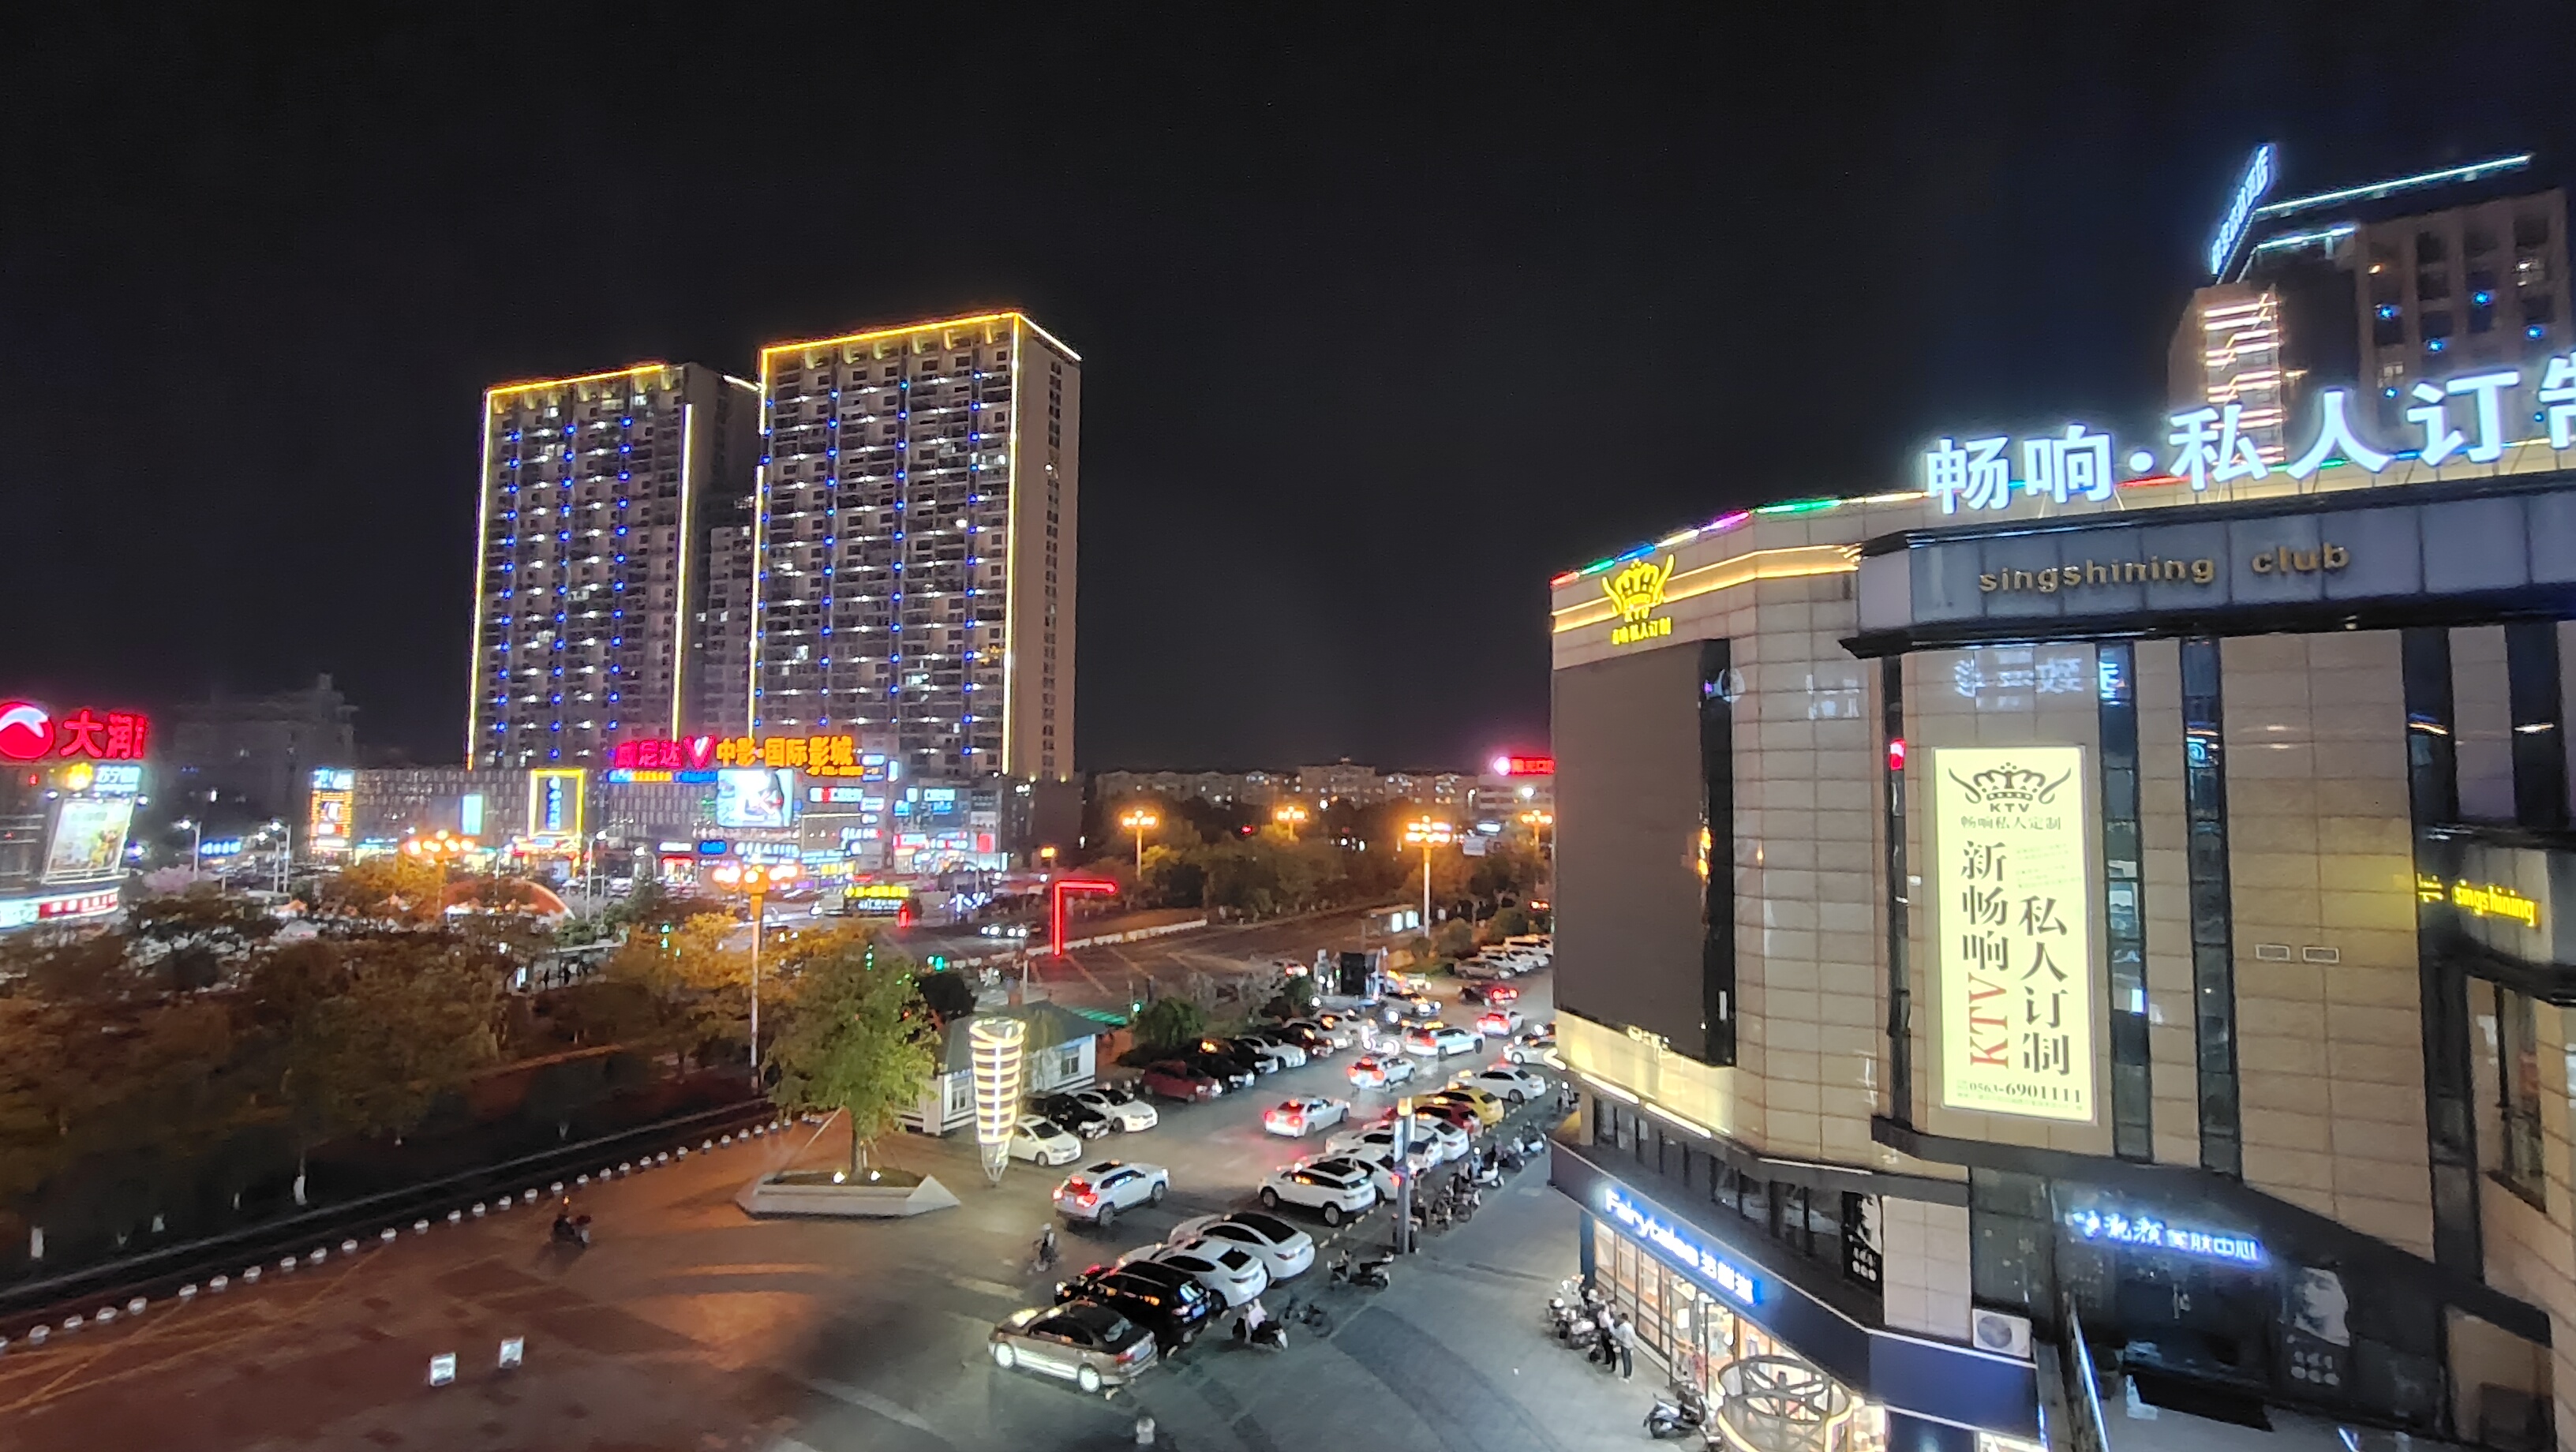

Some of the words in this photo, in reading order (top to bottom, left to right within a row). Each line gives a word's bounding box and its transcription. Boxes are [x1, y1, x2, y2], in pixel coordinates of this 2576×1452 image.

[1979, 556, 2215, 595] singshining
[2252, 543, 2350, 575] club
[716, 735, 854, 767] 中影·国际影城
[1990, 803, 2031, 813] KTV
[1960, 840, 2010, 971] 新畅响
[1968, 972, 2010, 1070] KTV
[2018, 893, 2072, 1078] 私人订制
